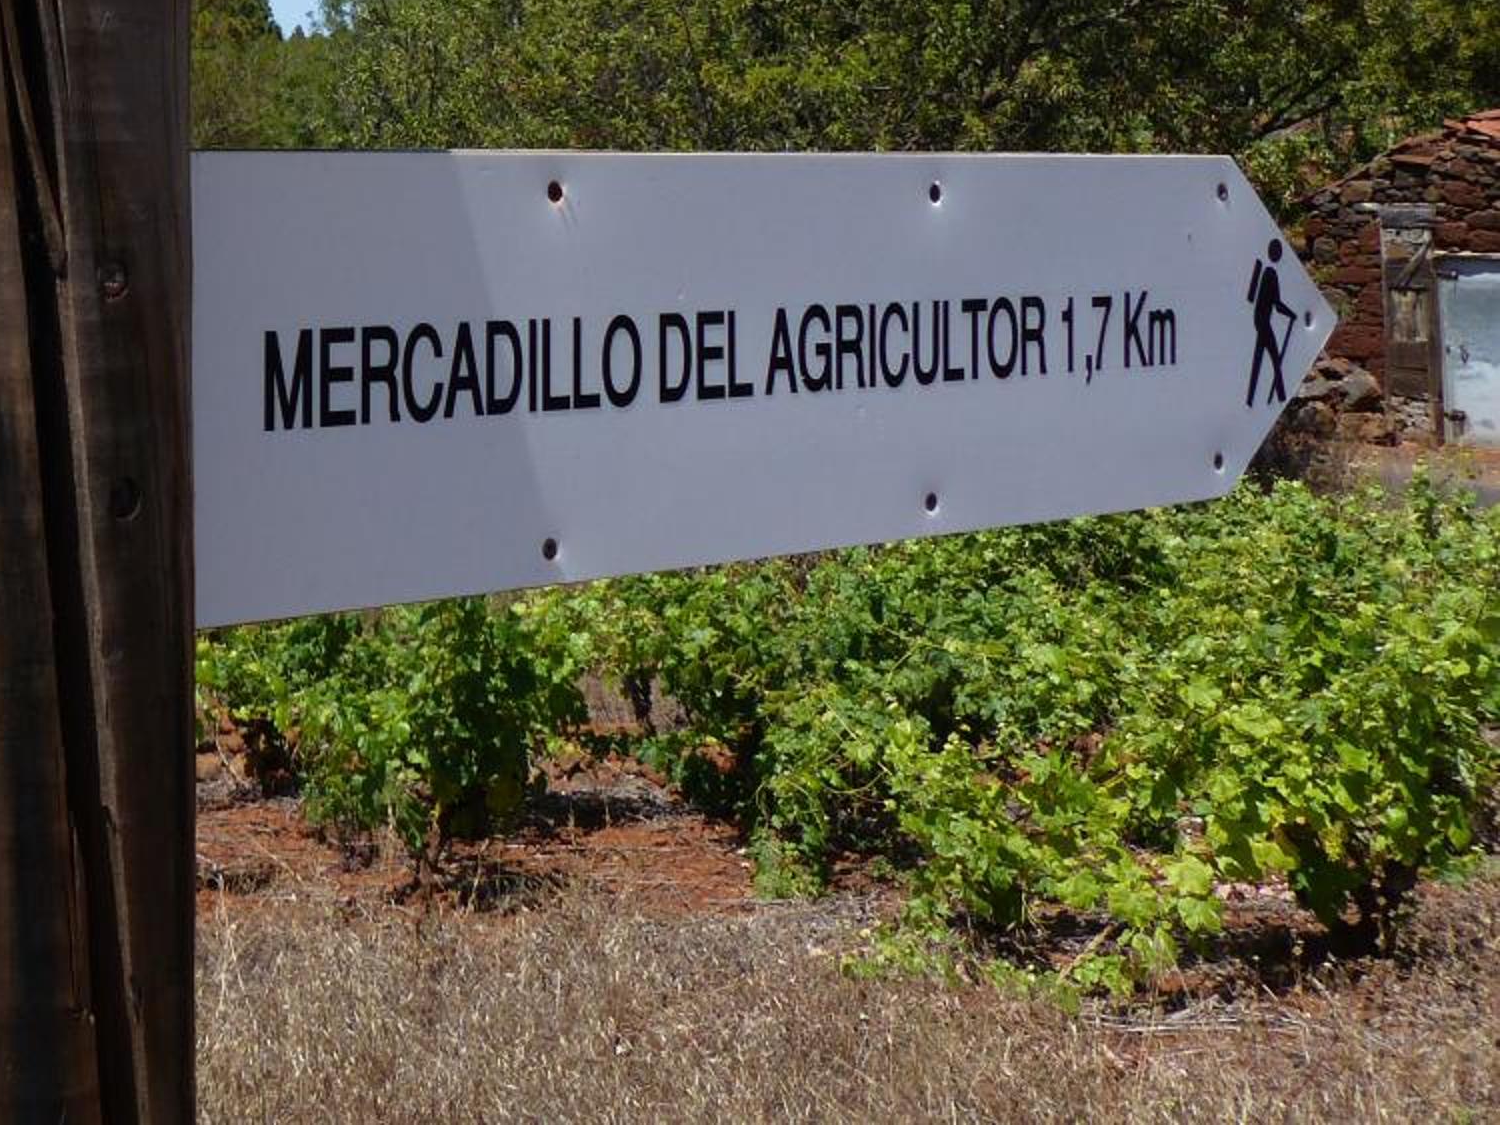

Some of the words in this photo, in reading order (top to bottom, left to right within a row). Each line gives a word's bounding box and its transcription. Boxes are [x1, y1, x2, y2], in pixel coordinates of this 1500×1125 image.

[263, 314, 642, 432] MERCADILLO
[659, 310, 754, 403] DEL
[766, 296, 1047, 396] AGRICULTOR
[1061, 296, 1112, 385] 1,7
[1123, 290, 1177, 369] Km
